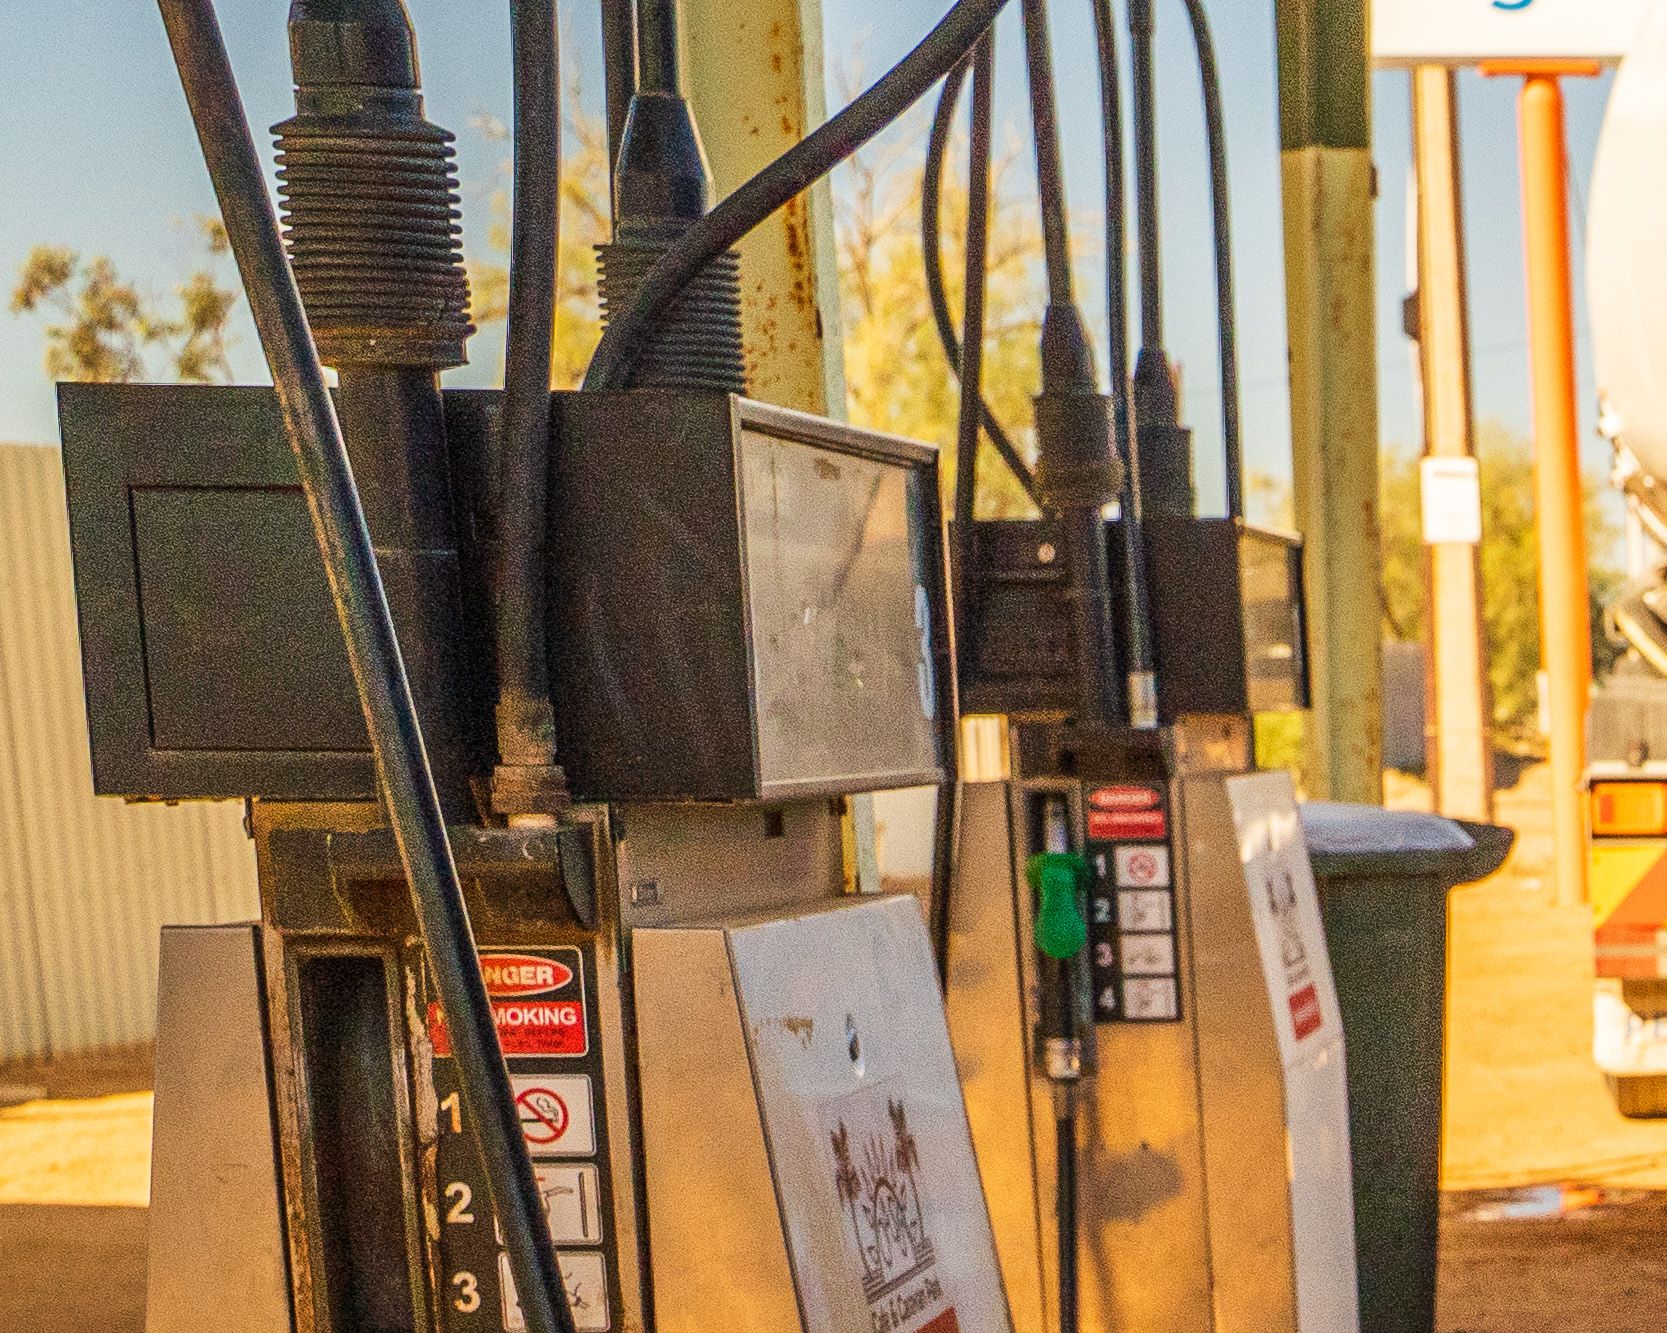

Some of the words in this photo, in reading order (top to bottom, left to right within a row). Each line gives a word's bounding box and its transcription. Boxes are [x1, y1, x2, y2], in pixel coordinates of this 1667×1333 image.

[1094, 854, 1106, 878] 1
[1094, 898, 1111, 922] 2
[1096, 942, 1114, 967] 3
[1099, 986, 1116, 1010] 4
[440, 1092, 462, 1133] 1
[444, 1181, 474, 1224] 2
[453, 1271, 481, 1313] 3
